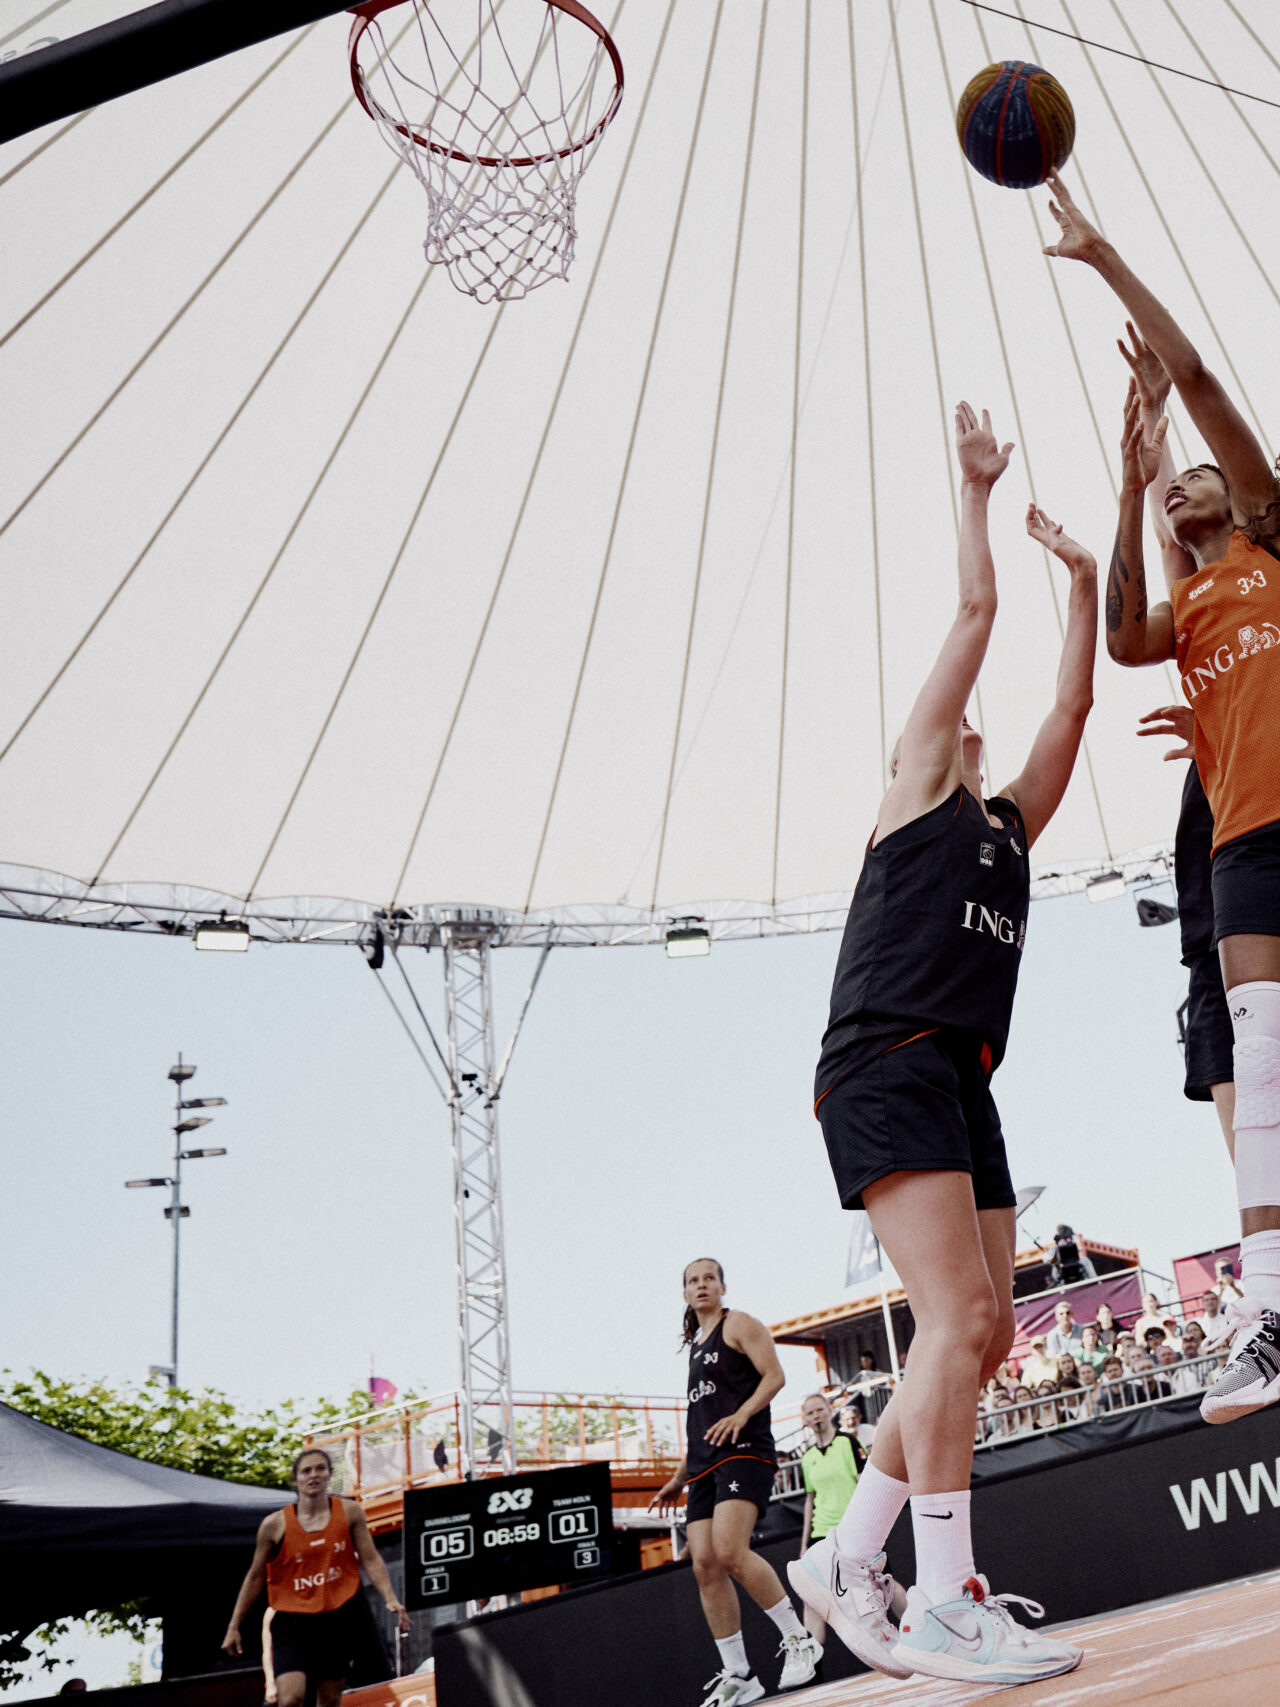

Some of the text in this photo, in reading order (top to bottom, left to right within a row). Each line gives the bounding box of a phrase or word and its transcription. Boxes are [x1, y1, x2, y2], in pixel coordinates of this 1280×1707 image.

[1182, 643, 1235, 699] ING
[961, 900, 1016, 944] ING
[483, 1522, 541, 1548] 06:59
[558, 1512, 589, 1536] 01
[430, 1533, 465, 1558] 05
[582, 1551, 592, 1564] 3
[293, 1573, 325, 1591] ING
[431, 1577, 440, 1591] 1
